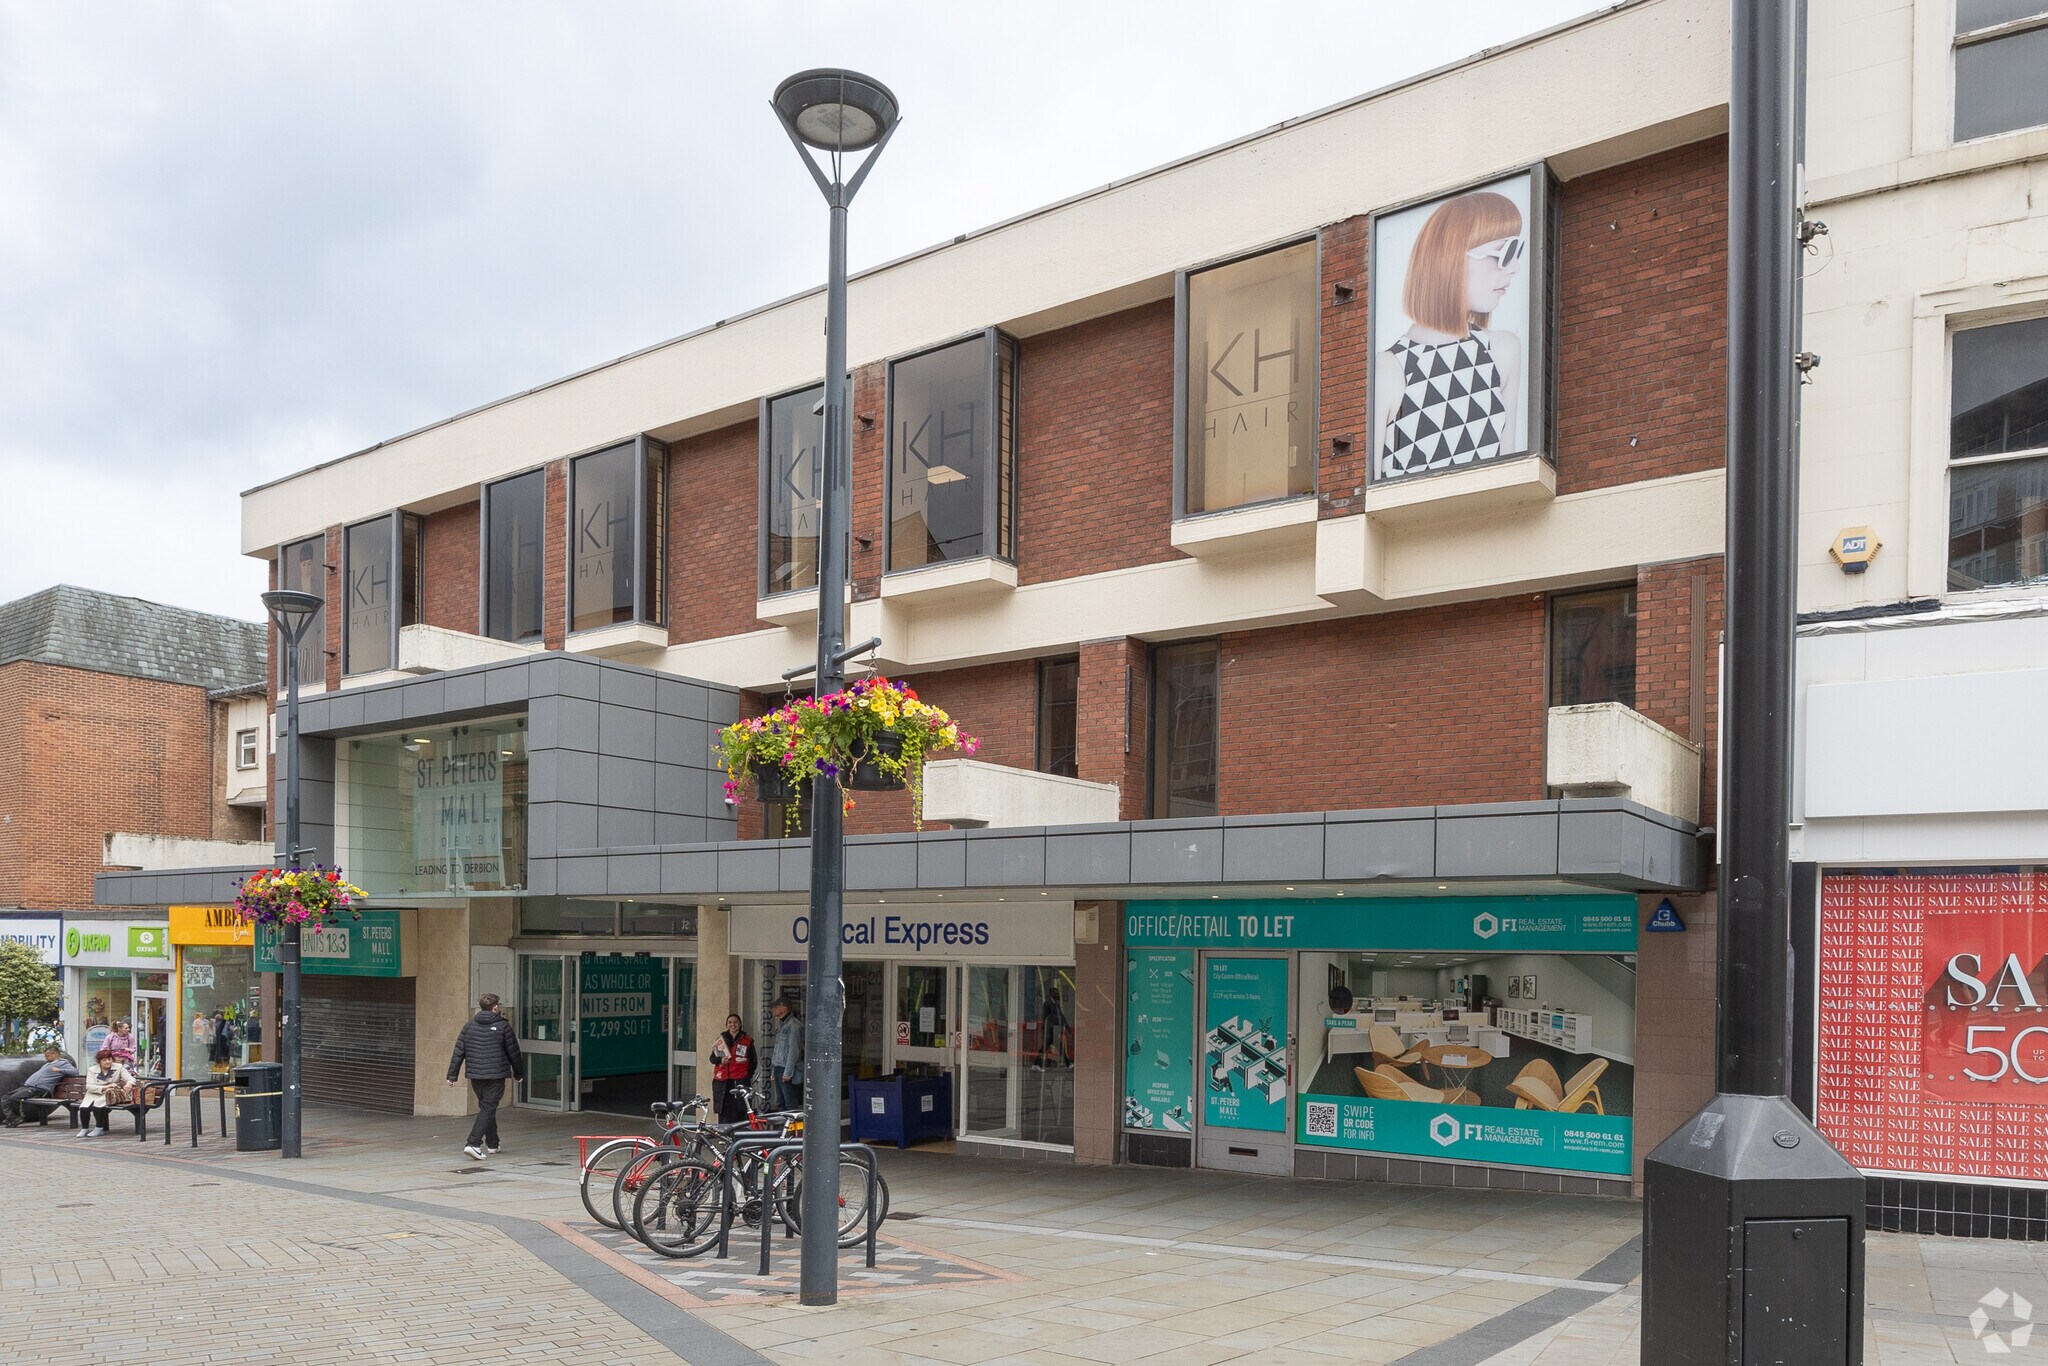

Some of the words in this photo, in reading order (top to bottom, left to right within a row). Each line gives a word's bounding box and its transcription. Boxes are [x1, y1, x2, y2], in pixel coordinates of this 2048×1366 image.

[1203, 318, 1299, 404] KH
[1204, 401, 1298, 438] HAIR
[903, 402, 974, 474] KH
[580, 495, 629, 554] KH
[1843, 539, 1866, 551] ADT
[353, 561, 389, 608] KH
[352, 610, 388, 630] HAIR
[415, 863, 447, 876] LEADING
[450, 863, 461, 874] TO
[464, 862, 499, 874] DERBION
[1825, 884, 1855, 893] SALE
[1859, 884, 1889, 893] SALE
[1894, 884, 1924, 893] SALE
[1929, 883, 1960, 892] SALE
[1965, 883, 1997, 892] SALE
[2002, 881, 2034, 891] SALE
[1824, 897, 1854, 906] SALE
[1858, 897, 1889, 906] SALE
[1893, 897, 1924, 906] SALE
[1929, 896, 1960, 906] SALE
[1965, 896, 1997, 906] SALE
[2001, 895, 2034, 905] SALE
[205, 909, 248, 927] AMBE
[1824, 910, 1854, 919] SALE
[1858, 910, 1888, 919] SALE
[1893, 910, 1924, 919] SALE
[1129, 914, 1232, 938] OFFICE/RETAIL
[1238, 916, 1258, 937] TO
[1264, 916, 1294, 937] LET
[1502, 918, 1517, 932] FI
[792, 916, 875, 945] Ocal
[885, 916, 989, 951] Express
[1824, 936, 1853, 945] SALE
[1858, 936, 1888, 945] SALE
[1892, 935, 1923, 946] SALE
[82, 934, 111, 952] OXFAM
[326, 933, 347, 953] 1&3
[261, 946, 275, 962] 2,29
[1823, 961, 1853, 971] SALE
[1857, 962, 1887, 971] SALE
[1892, 962, 1923, 972] SALE
[584, 974, 598, 990] AS
[601, 974, 634, 990] WHOLE
[638, 974, 651, 989] OR
[1947, 952, 2048, 1007] SA
[1822, 987, 1852, 997] SALE
[1856, 988, 1887, 997] SALE
[1891, 988, 1922, 998] SALE
[582, 997, 610, 1013] NITS
[614, 997, 645, 1014] FROM
[761, 964, 776, 1038] Contact
[624, 1020, 637, 1035] SQ
[640, 1019, 651, 1033] FT
[1822, 1013, 1852, 1022] SALE
[1856, 1014, 1886, 1023] SALE
[1891, 1015, 1922, 1025] SALE
[1821, 1038, 1851, 1048] SALE
[1855, 1040, 1886, 1050] SALE
[1890, 1041, 1921, 1051] SALE
[760, 1043, 775, 1114] Lenses
[1820, 1076, 1850, 1087] SALE
[1855, 1078, 1885, 1089] SALE
[1889, 1080, 1920, 1090] SALE
[1343, 1104, 1375, 1119] SWIPE
[1820, 1102, 1850, 1113] SALE
[1854, 1104, 1884, 1115] SALE
[1888, 1106, 1919, 1117] SALE
[1924, 1108, 1955, 1119] SALE
[1960, 1110, 1992, 1121] SALE
[1997, 1111, 2029, 1122] SALE
[1343, 1118, 1354, 1128] QR
[1355, 1119, 1374, 1129] CODE
[1484, 1125, 1506, 1135] REAL
[1508, 1127, 1540, 1138] ESTATE
[1343, 1128, 1357, 1139] FOR
[1358, 1130, 1375, 1141] INFO
[1464, 1123, 1483, 1141] FI
[1484, 1133, 1545, 1146] MANAGEMENT
[1564, 1129, 1585, 1138] 0845
[1585, 1131, 1601, 1139] 500
[1602, 1132, 1613, 1140] 61
[1613, 1133, 1625, 1142] 61
[1820, 1128, 1849, 1138] SALE
[1853, 1130, 1883, 1140] SALE
[1888, 1132, 1919, 1143] SALE
[1923, 1135, 1954, 1145] SALE
[1959, 1137, 1991, 1148] SALE
[1996, 1138, 2029, 1149] SALE
[1563, 1145, 1625, 1155] enquiries@fi-rem.com
[1564, 1137, 1625, 1148] www.fi-rem.com
[1853, 1156, 1883, 1167] SALE
[1887, 1158, 1918, 1169] SALE
[1923, 1161, 1954, 1172] SALE
[1959, 1164, 1991, 1175] SALE
[1996, 1165, 2028, 1177] SALE
